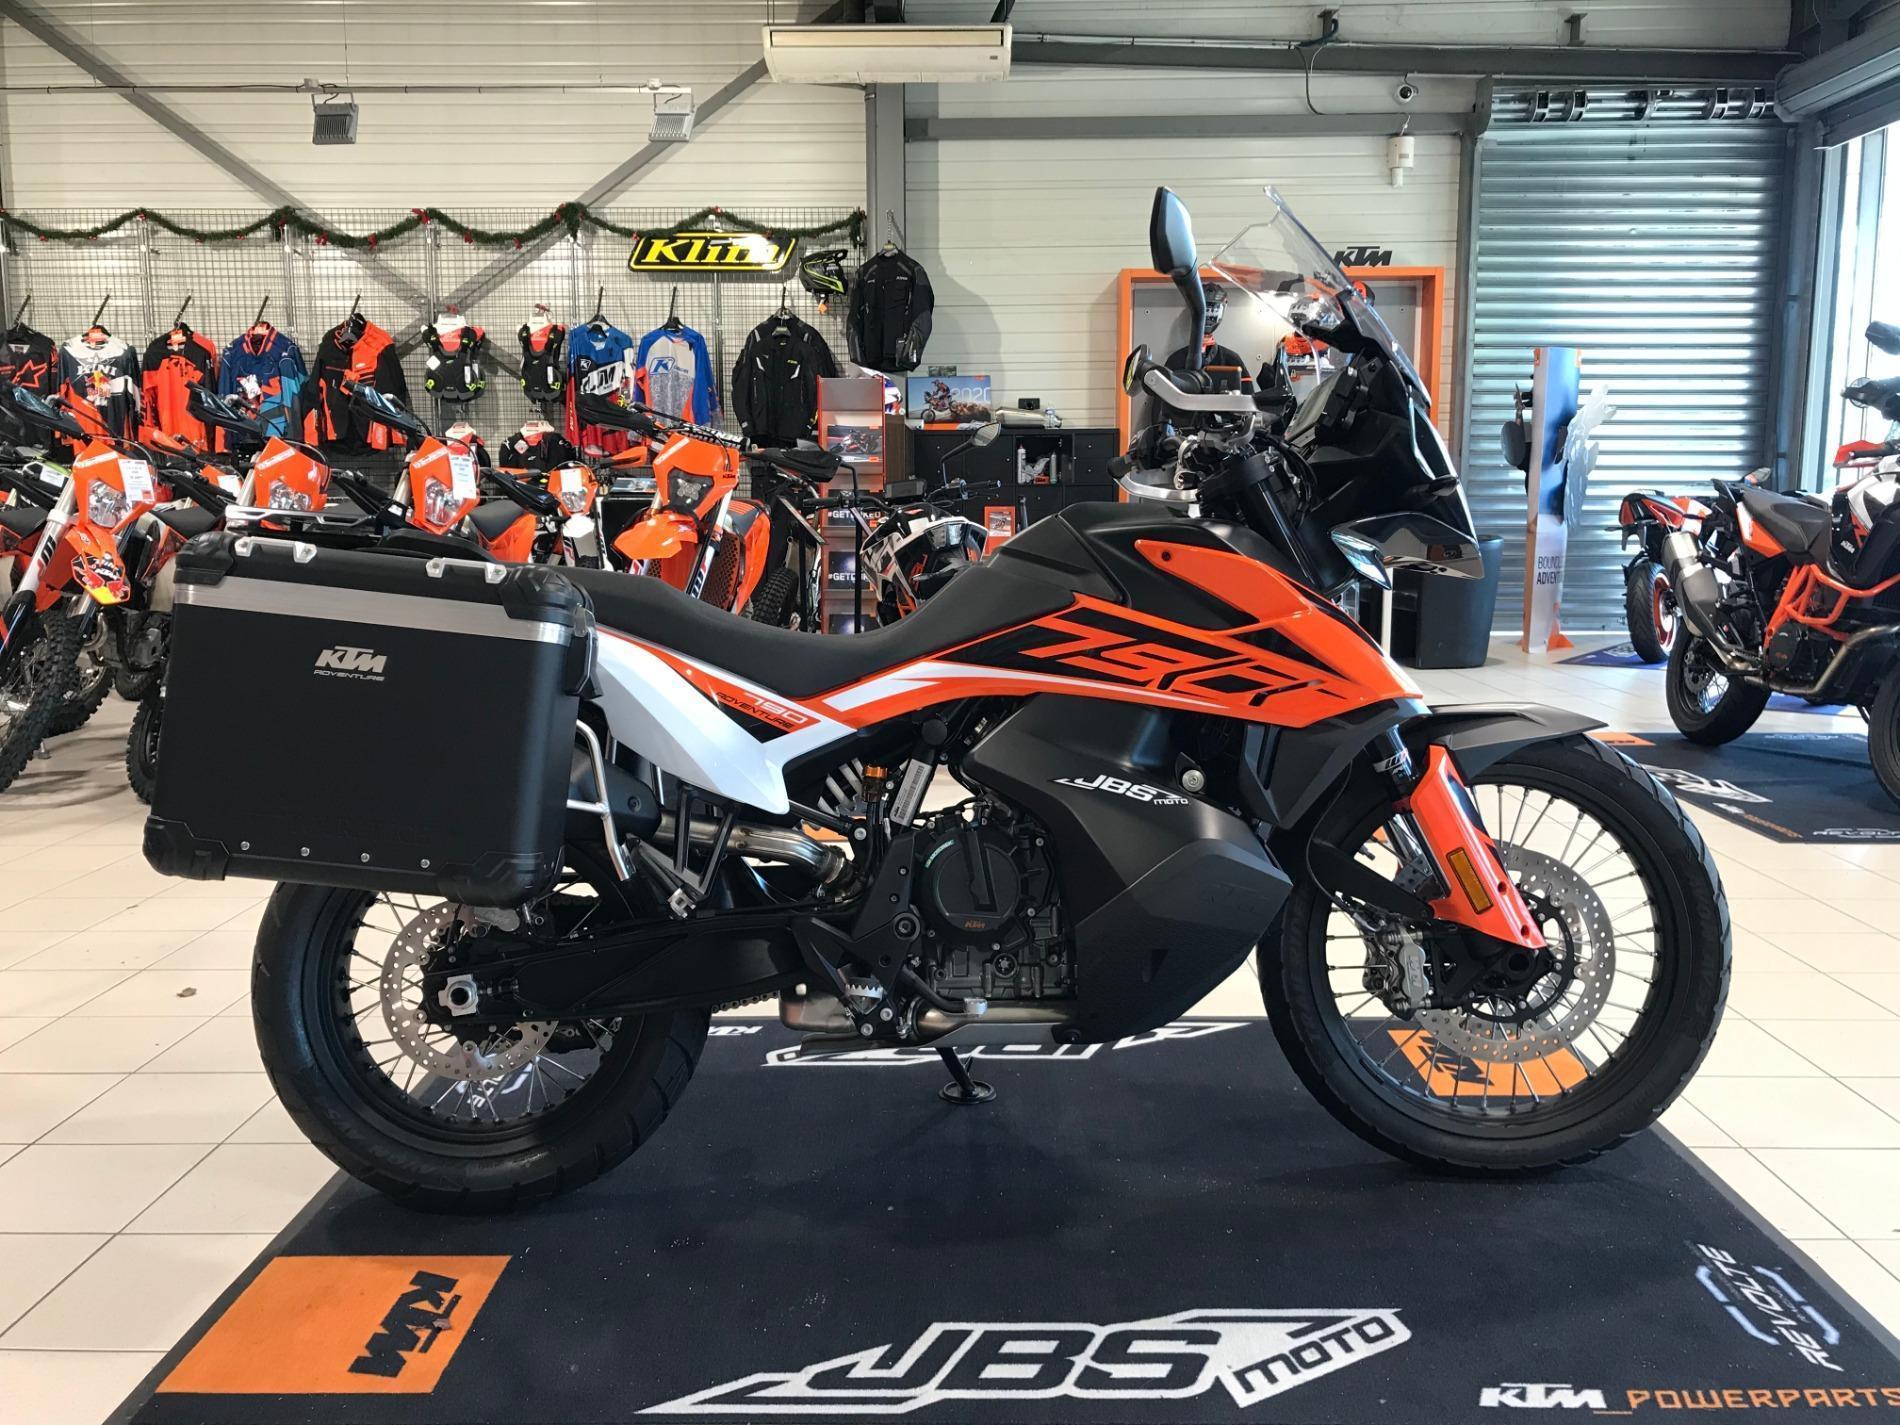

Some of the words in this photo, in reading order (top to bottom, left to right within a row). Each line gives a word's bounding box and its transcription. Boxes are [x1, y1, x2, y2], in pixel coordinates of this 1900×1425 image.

[640, 237, 781, 263] Klim
[1334, 245, 1392, 267] KTM
[314, 645, 388, 674] KTM
[313, 669, 386, 682] ADVENTURE
[715, 691, 795, 729] ADVENTURE
[743, 690, 809, 725] 790
[1073, 774, 1158, 802] JBS
[348, 1270, 462, 1378] KTM
[803, 1328, 1223, 1392] JBS
[1478, 1382, 1608, 1409] KTM
